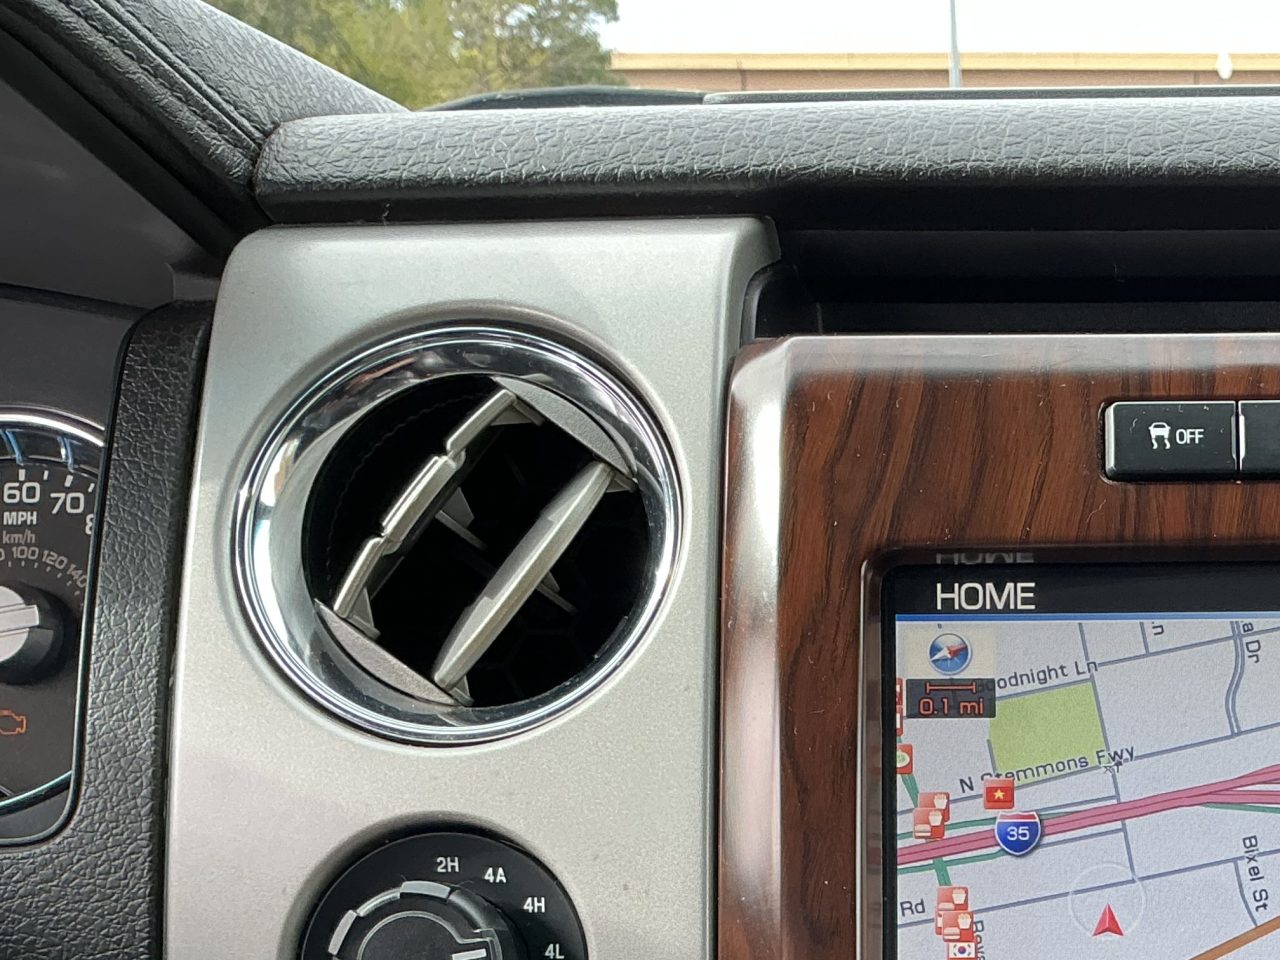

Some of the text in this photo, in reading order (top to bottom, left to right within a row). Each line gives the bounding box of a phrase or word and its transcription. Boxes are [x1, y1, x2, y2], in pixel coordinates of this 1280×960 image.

[1176, 429, 1204, 445] OFF
[3, 482, 41, 504] 60
[50, 492, 85, 514] 70
[3, 511, 37, 526] MPH
[2, 529, 36, 544] km/h
[11, 546, 39, 560] 100
[41, 550, 68, 570] 120
[66, 563, 87, 588] 140
[936, 582, 1036, 610] HOME
[1245, 639, 1262, 664] Dr
[1074, 660, 1099, 676] Ln
[919, 698, 985, 715] 0.1 mi
[959, 777, 974, 793] N
[1096, 744, 1135, 766] Fwy
[1006, 825, 1030, 840] 35
[436, 857, 460, 873] 2H
[1242, 835, 1269, 912] Bixel St
[484, 867, 507, 884] 4A
[523, 897, 546, 913] 4H
[900, 898, 926, 917] Rd
[544, 944, 565, 960] 4L
